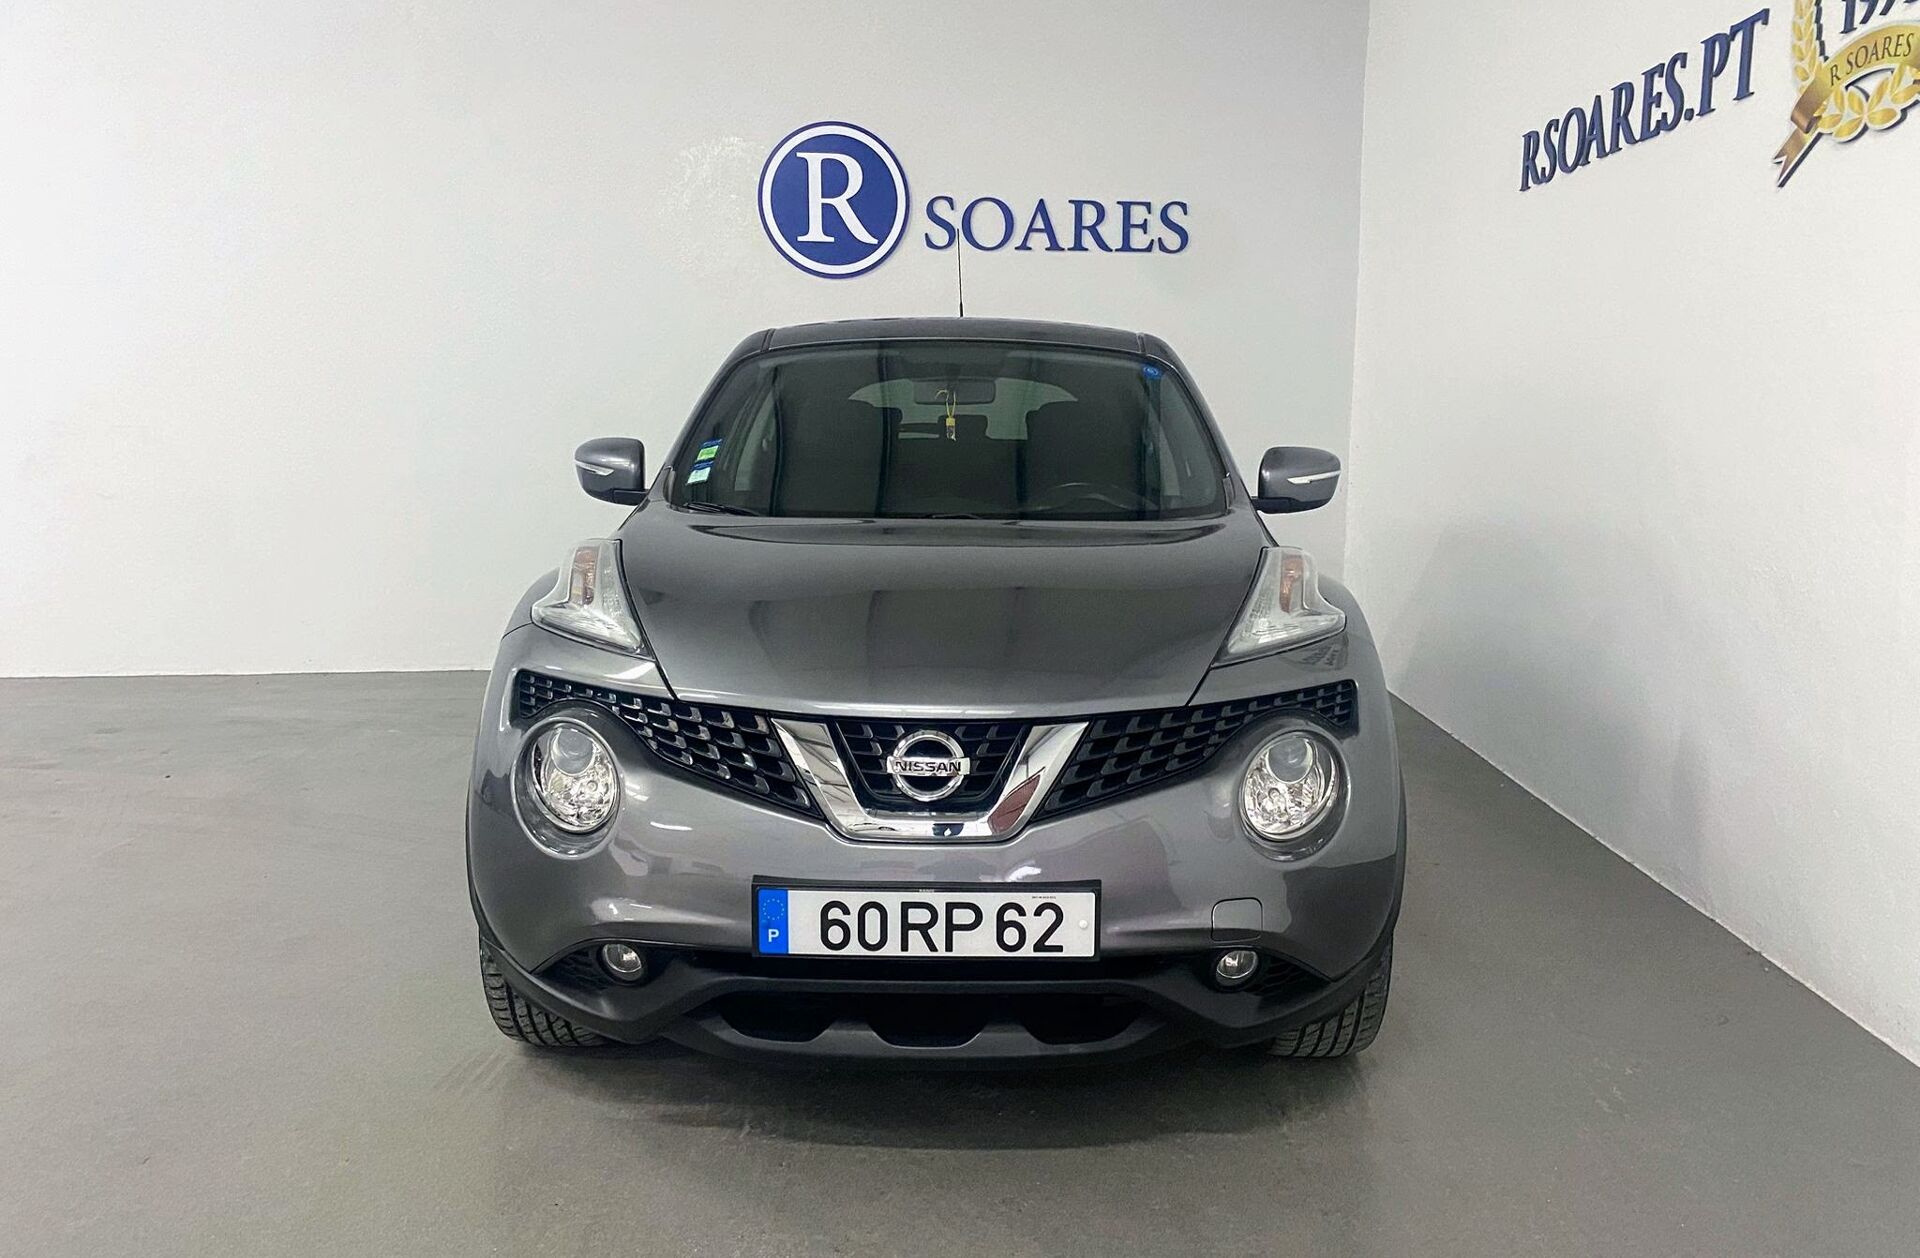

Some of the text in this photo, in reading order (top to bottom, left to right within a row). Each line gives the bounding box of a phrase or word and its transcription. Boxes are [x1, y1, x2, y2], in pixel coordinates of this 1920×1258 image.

[1829, 32, 1915, 87] R SOARES
[1519, 8, 1770, 192] RSOARES.PT
[796, 152, 1190, 254] R SOARES
[895, 760, 961, 773] NISSAN
[768, 928, 780, 943] P
